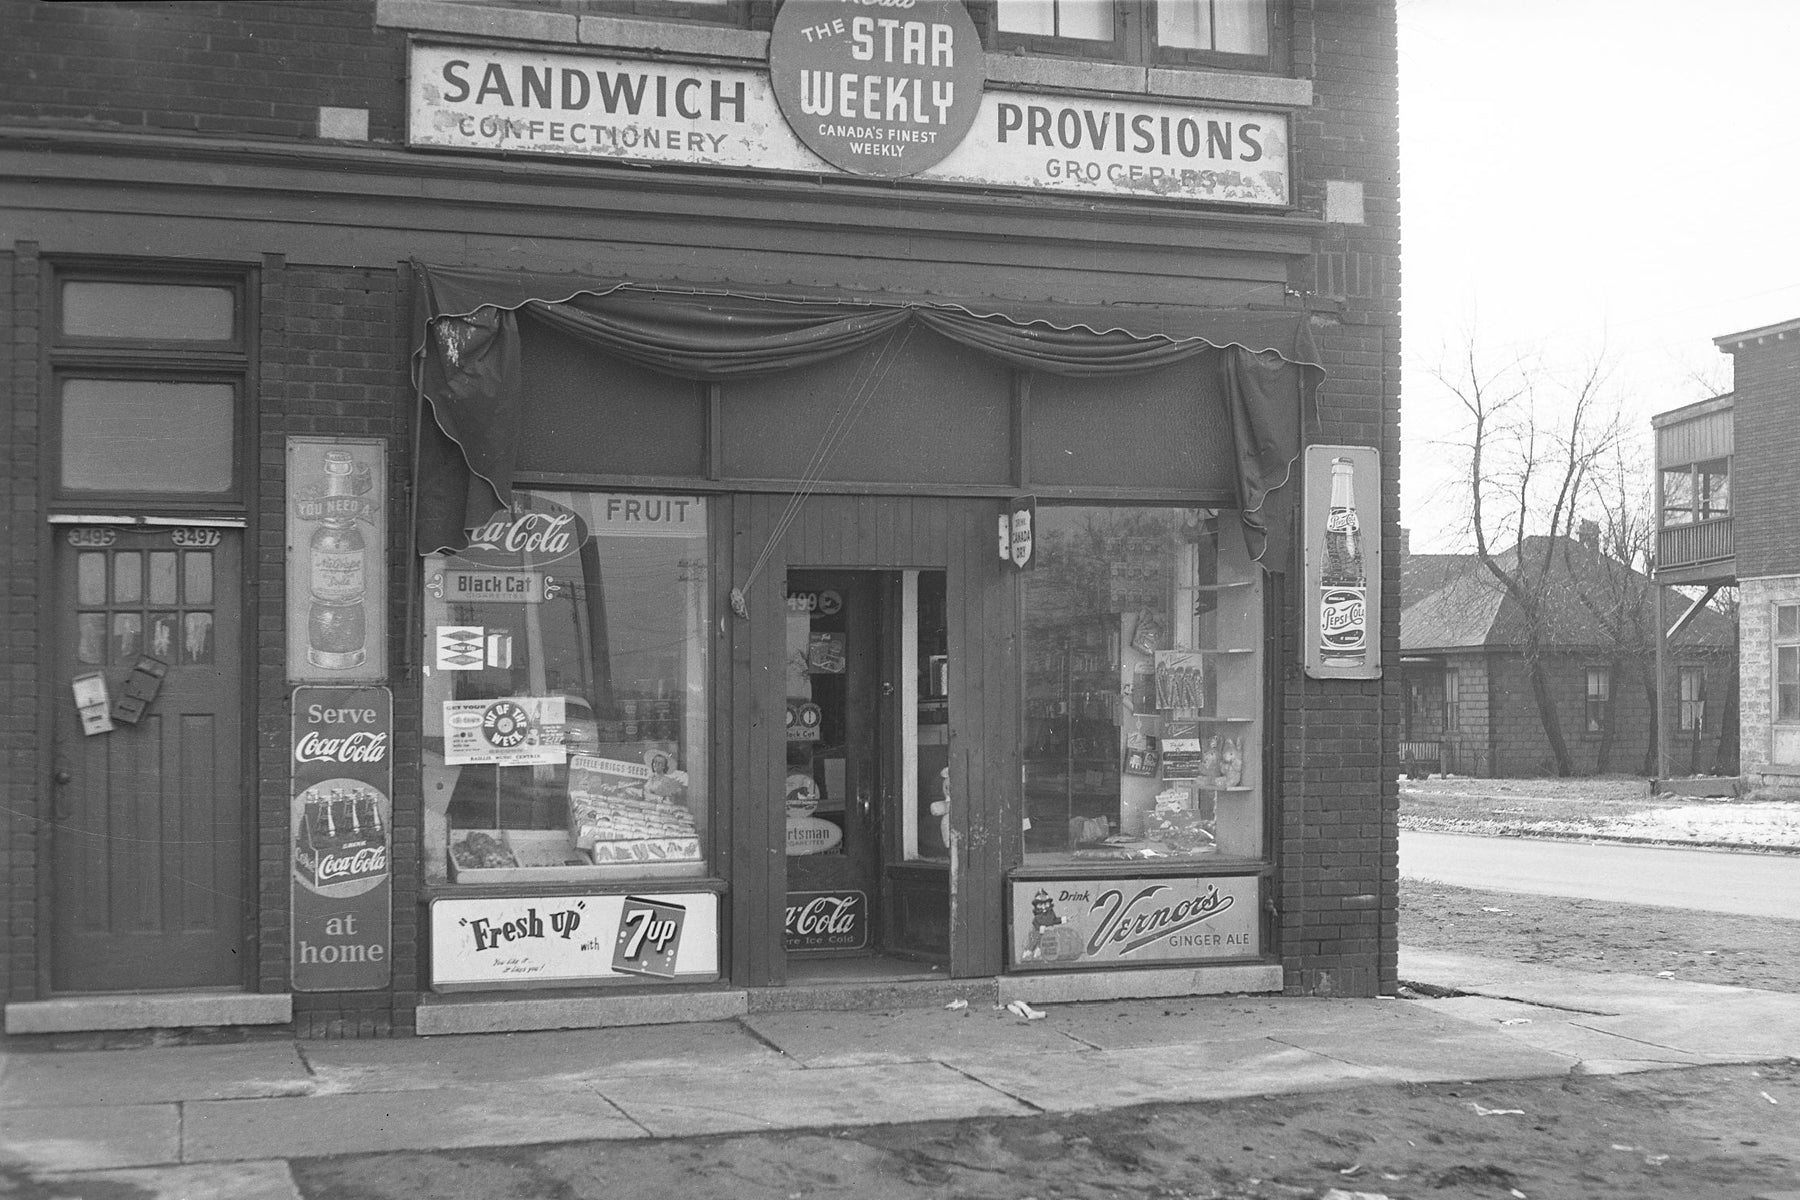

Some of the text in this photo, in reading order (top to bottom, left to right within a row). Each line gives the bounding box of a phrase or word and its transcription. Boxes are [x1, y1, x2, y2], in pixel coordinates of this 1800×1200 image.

[801, 16, 954, 68] THE STAR
[442, 60, 745, 123] SANDWICH
[800, 69, 954, 125] WEEKLY
[458, 115, 728, 154] CONFECTIONERY
[818, 124, 937, 143] CANADA'S FINEST
[997, 102, 1263, 162] PROVISIONS
[850, 142, 905, 157] WEEKLY
[327, 500, 358, 512] NEED
[607, 500, 689, 521] FRUIT
[71, 529, 112, 543] 3495
[176, 529, 216, 543] 3497
[471, 513, 575, 552] ca-Cola
[458, 576, 531, 592] Black Cat
[307, 704, 376, 723] Serve
[485, 710, 497, 727] HIT
[496, 704, 509, 715] OF
[513, 708, 527, 728] THE
[492, 731, 523, 747] WEEK
[786, 730, 800, 738] lack
[296, 731, 387, 763] Coca-Cola
[787, 827, 830, 841] rtsman
[319, 846, 386, 879] Coca-Cola
[1058, 890, 1091, 903] Drink
[325, 915, 358, 936] at
[786, 896, 860, 935] a-Cola
[1087, 885, 1234, 956] Vernor's
[580, 940, 600, 952] with
[786, 935, 854, 946] re Ice Cold
[1169, 934, 1250, 948] GINGER ALE
[300, 942, 384, 964] home
